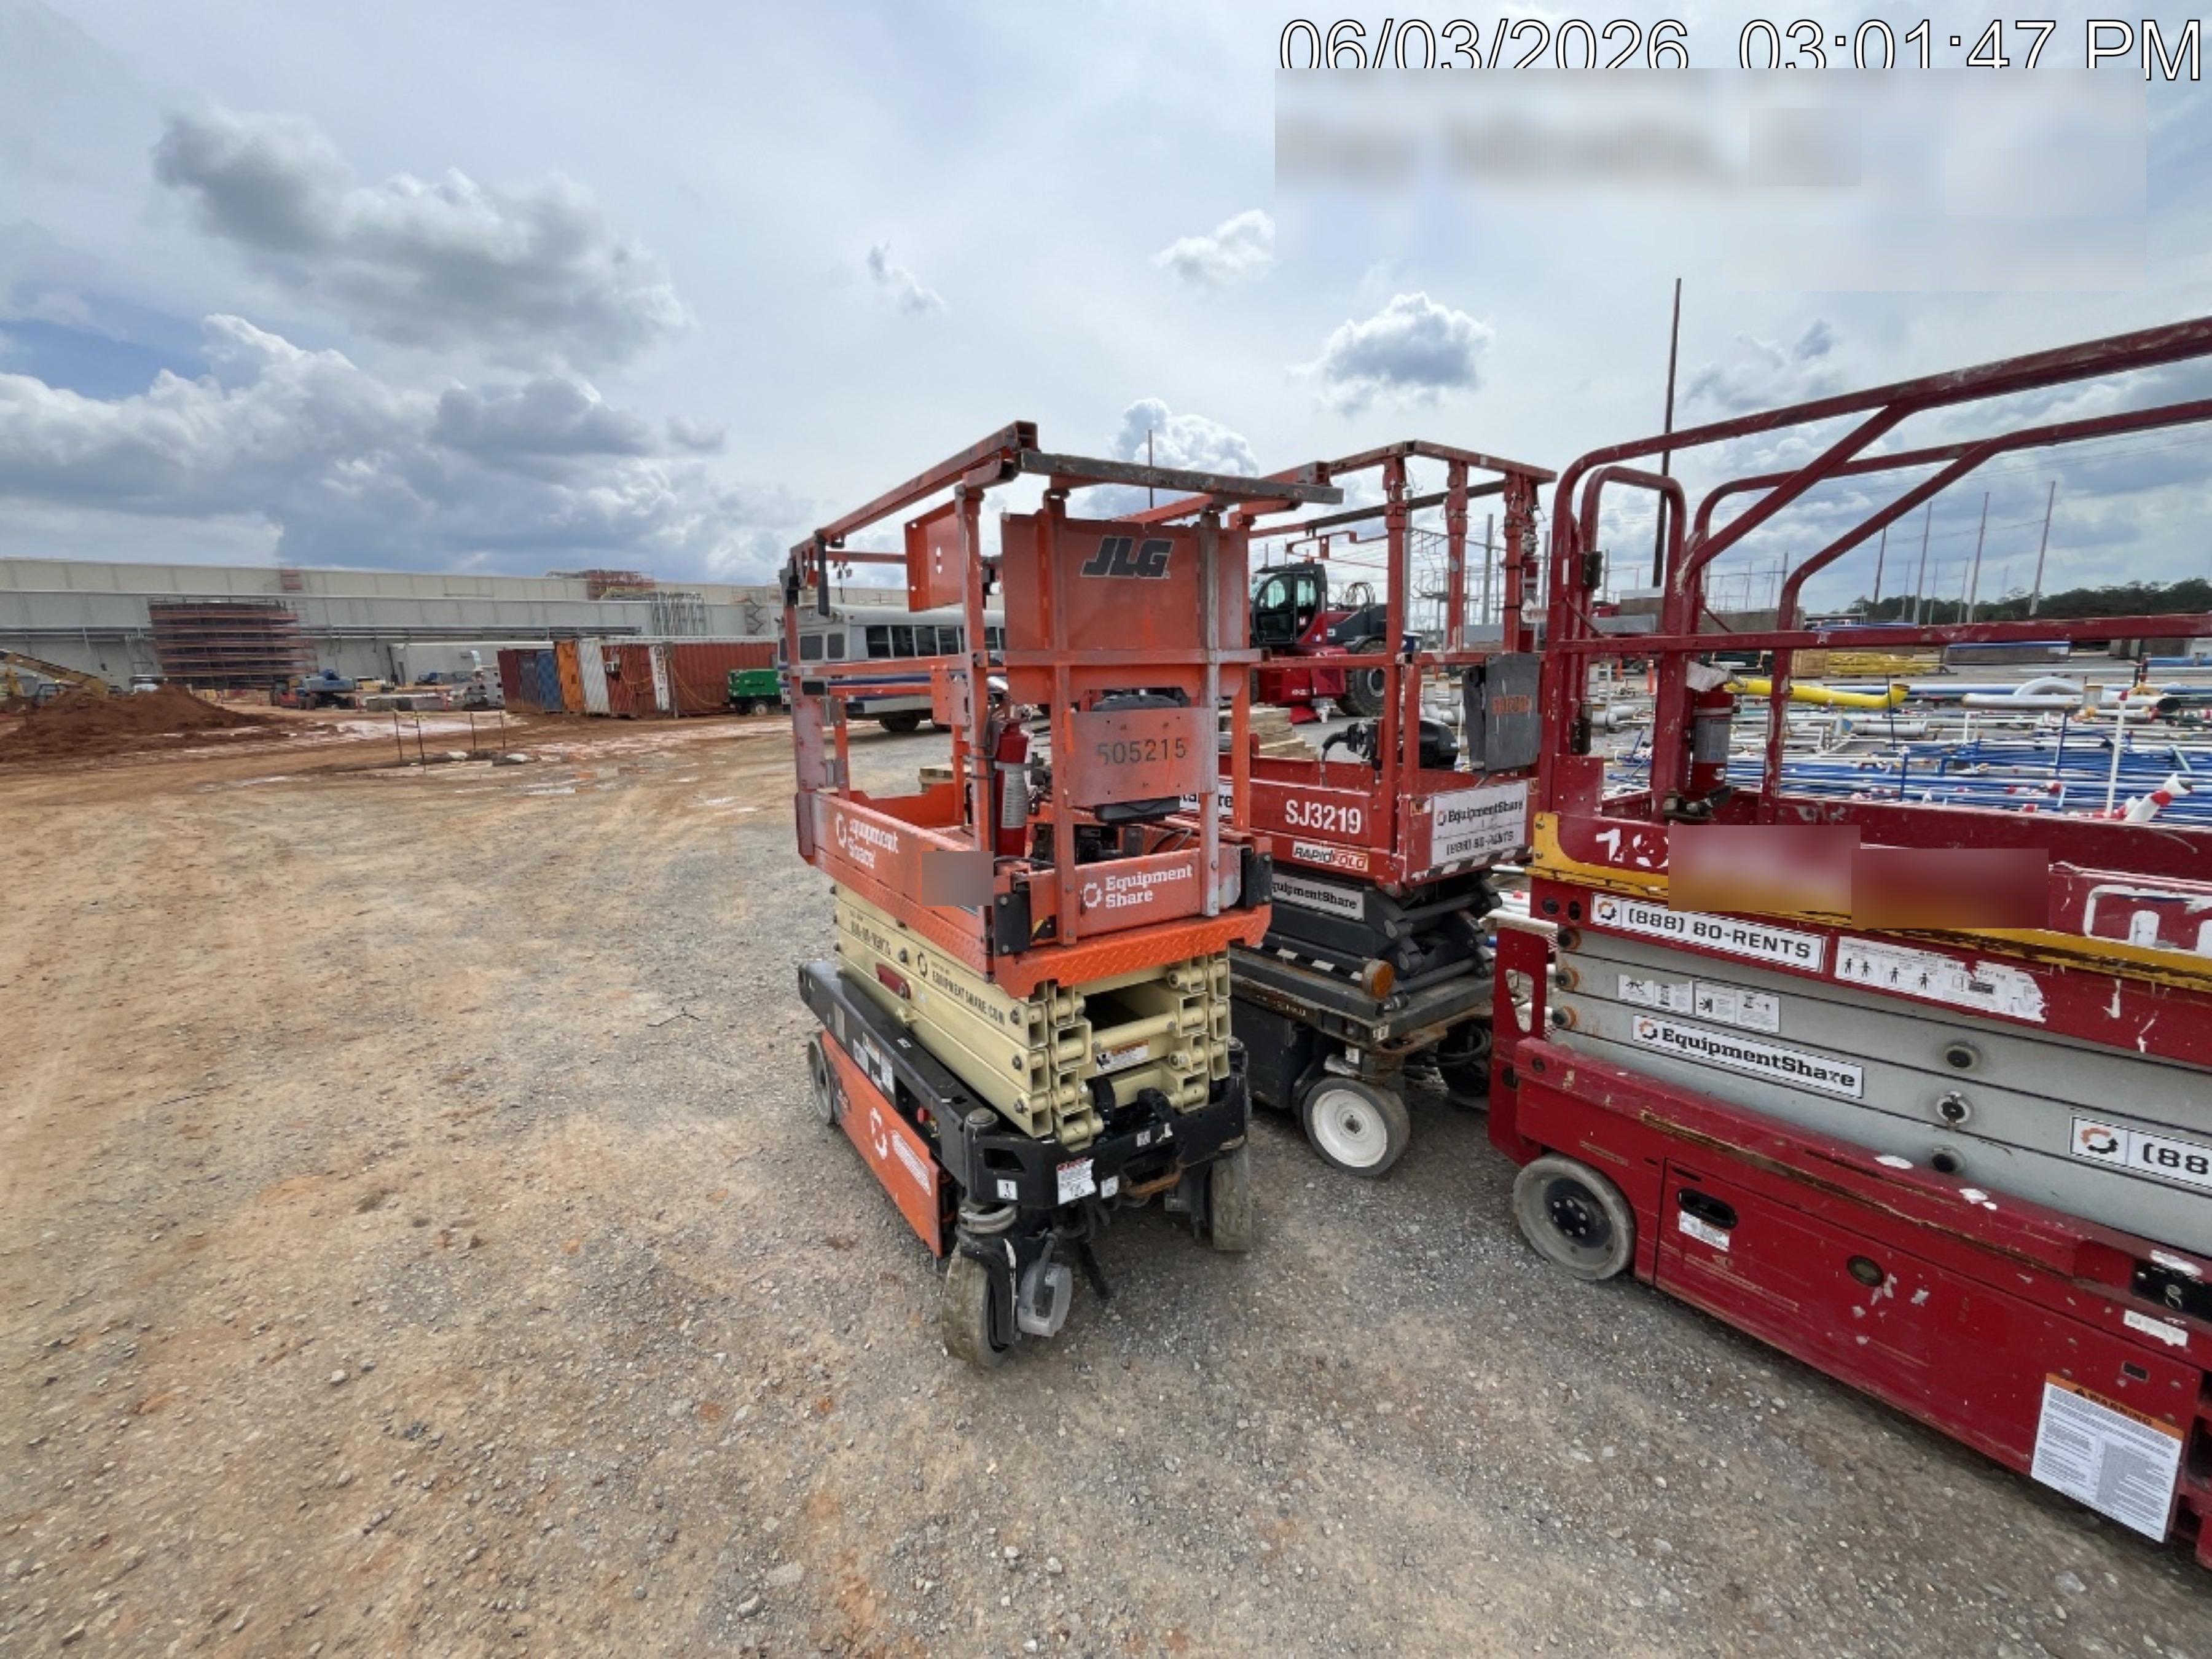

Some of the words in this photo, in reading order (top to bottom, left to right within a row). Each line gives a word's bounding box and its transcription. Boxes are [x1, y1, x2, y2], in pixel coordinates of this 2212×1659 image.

[1080, 535, 1175, 579] JLG
[1285, 799, 1362, 834] SJ3219
[1106, 864, 1193, 892] Equipment
[1106, 890, 1153, 909] Share
[1272, 882, 1357, 909] quipmentShare
[1629, 908, 1684, 933] (888)
[1693, 923, 1810, 959] 80-RENTS
[1662, 1027, 1855, 1088] EquipmentShare
[2143, 1142, 2209, 1175] (88
